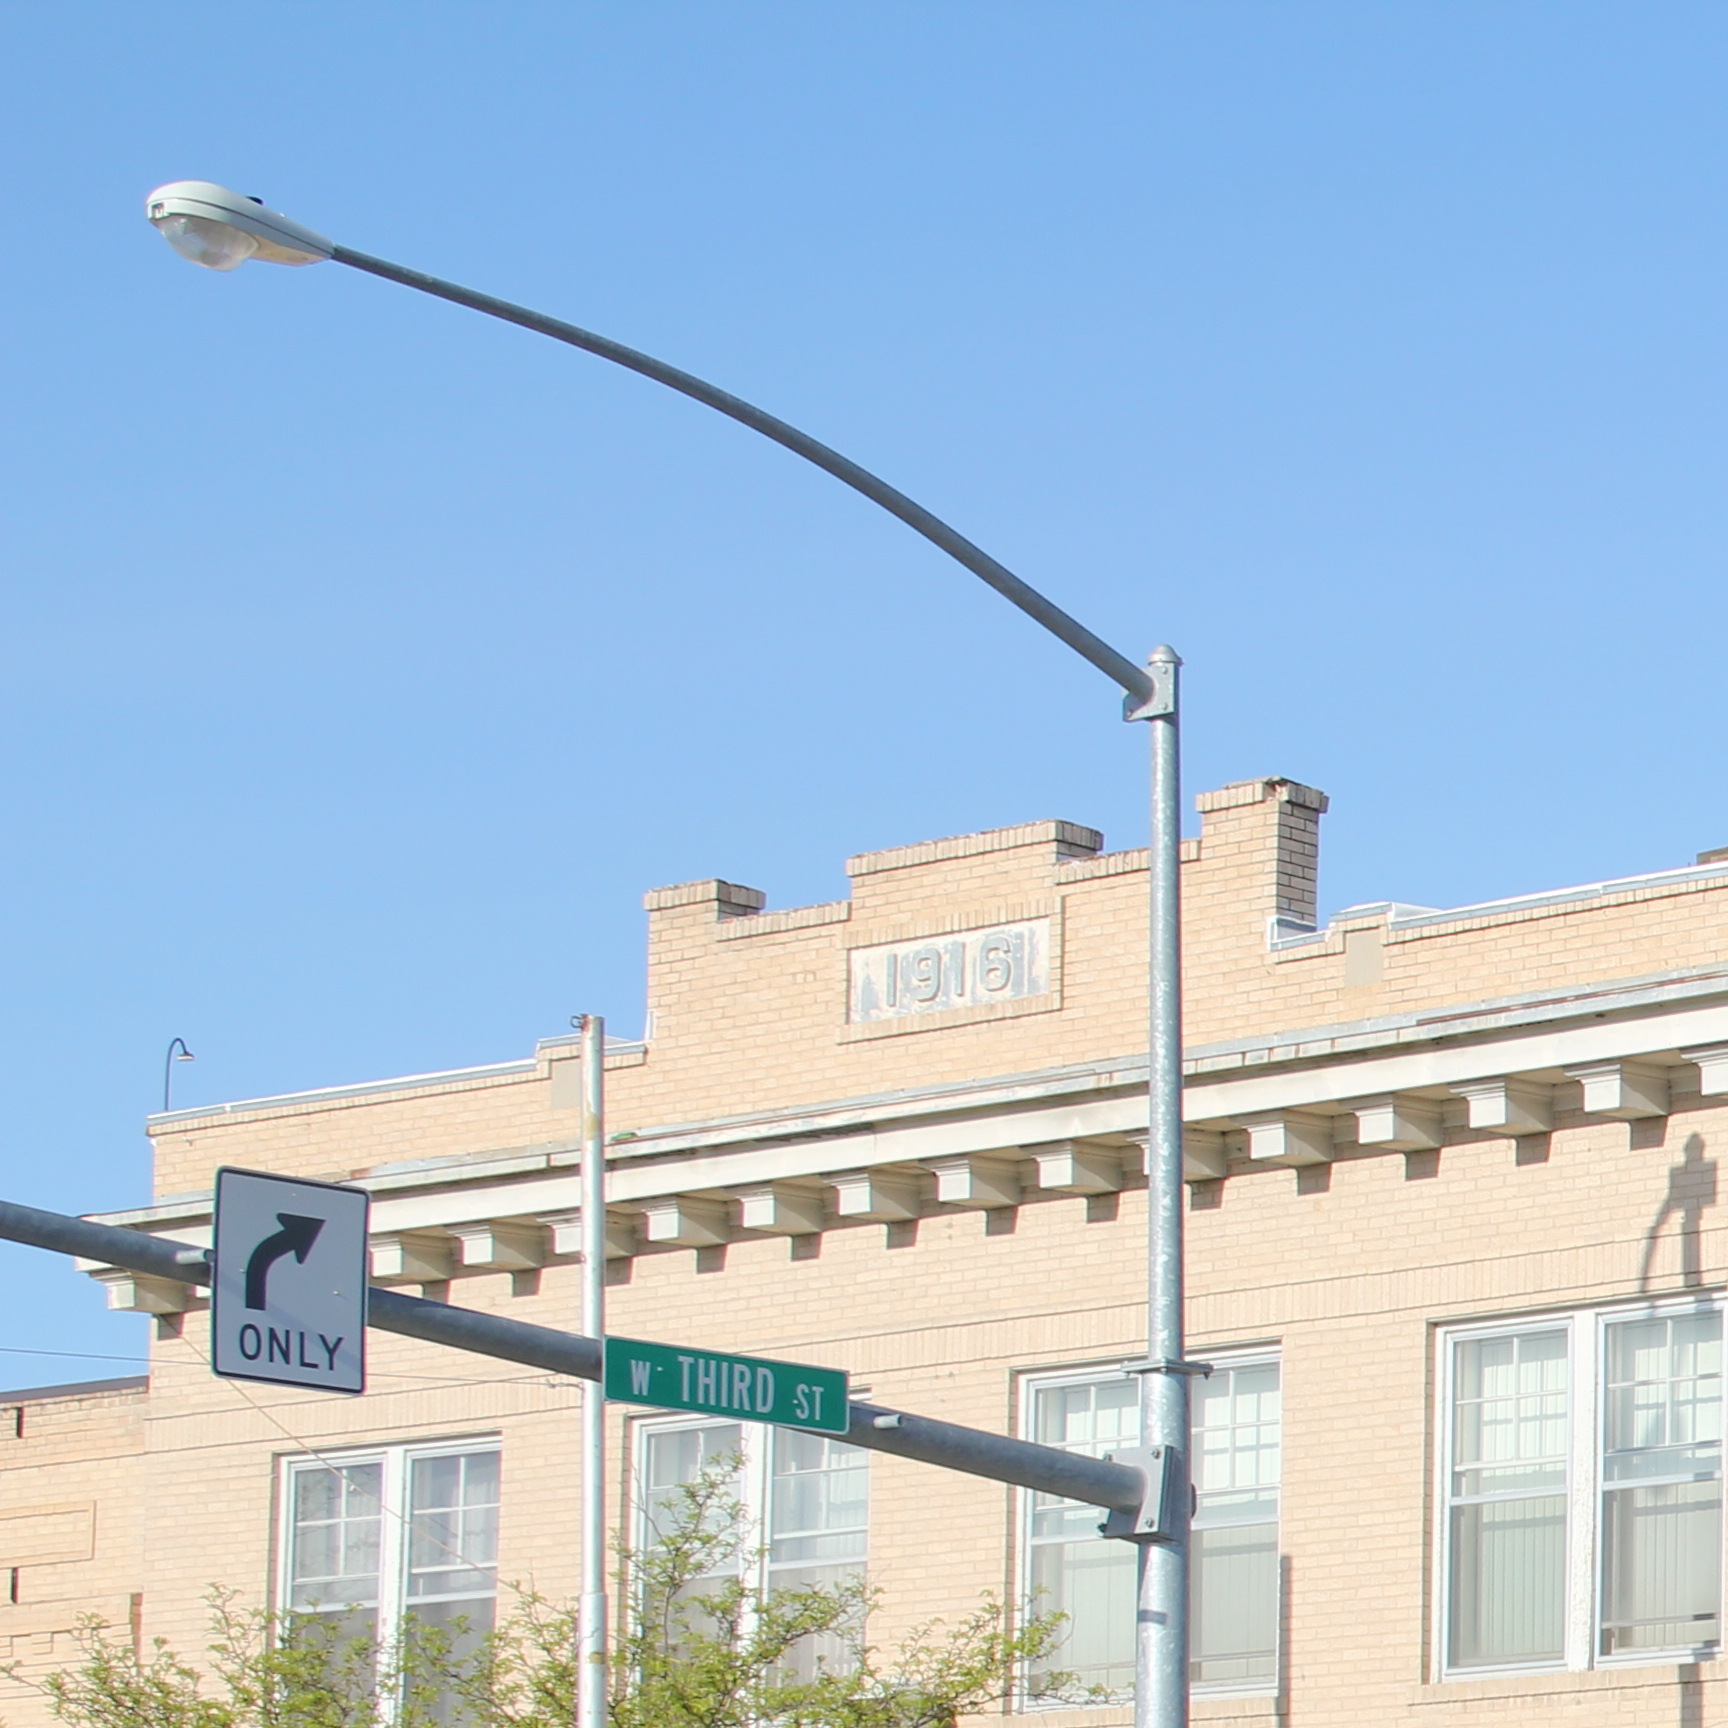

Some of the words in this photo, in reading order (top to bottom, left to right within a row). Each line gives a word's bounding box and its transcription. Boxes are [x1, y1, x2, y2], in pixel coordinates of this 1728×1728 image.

[886, 934, 1012, 1007] 1916
[239, 1323, 345, 1371] ONLY
[630, 1357, 650, 1396] W
[677, 1354, 775, 1415] THIRD
[795, 1383, 824, 1421] ST
